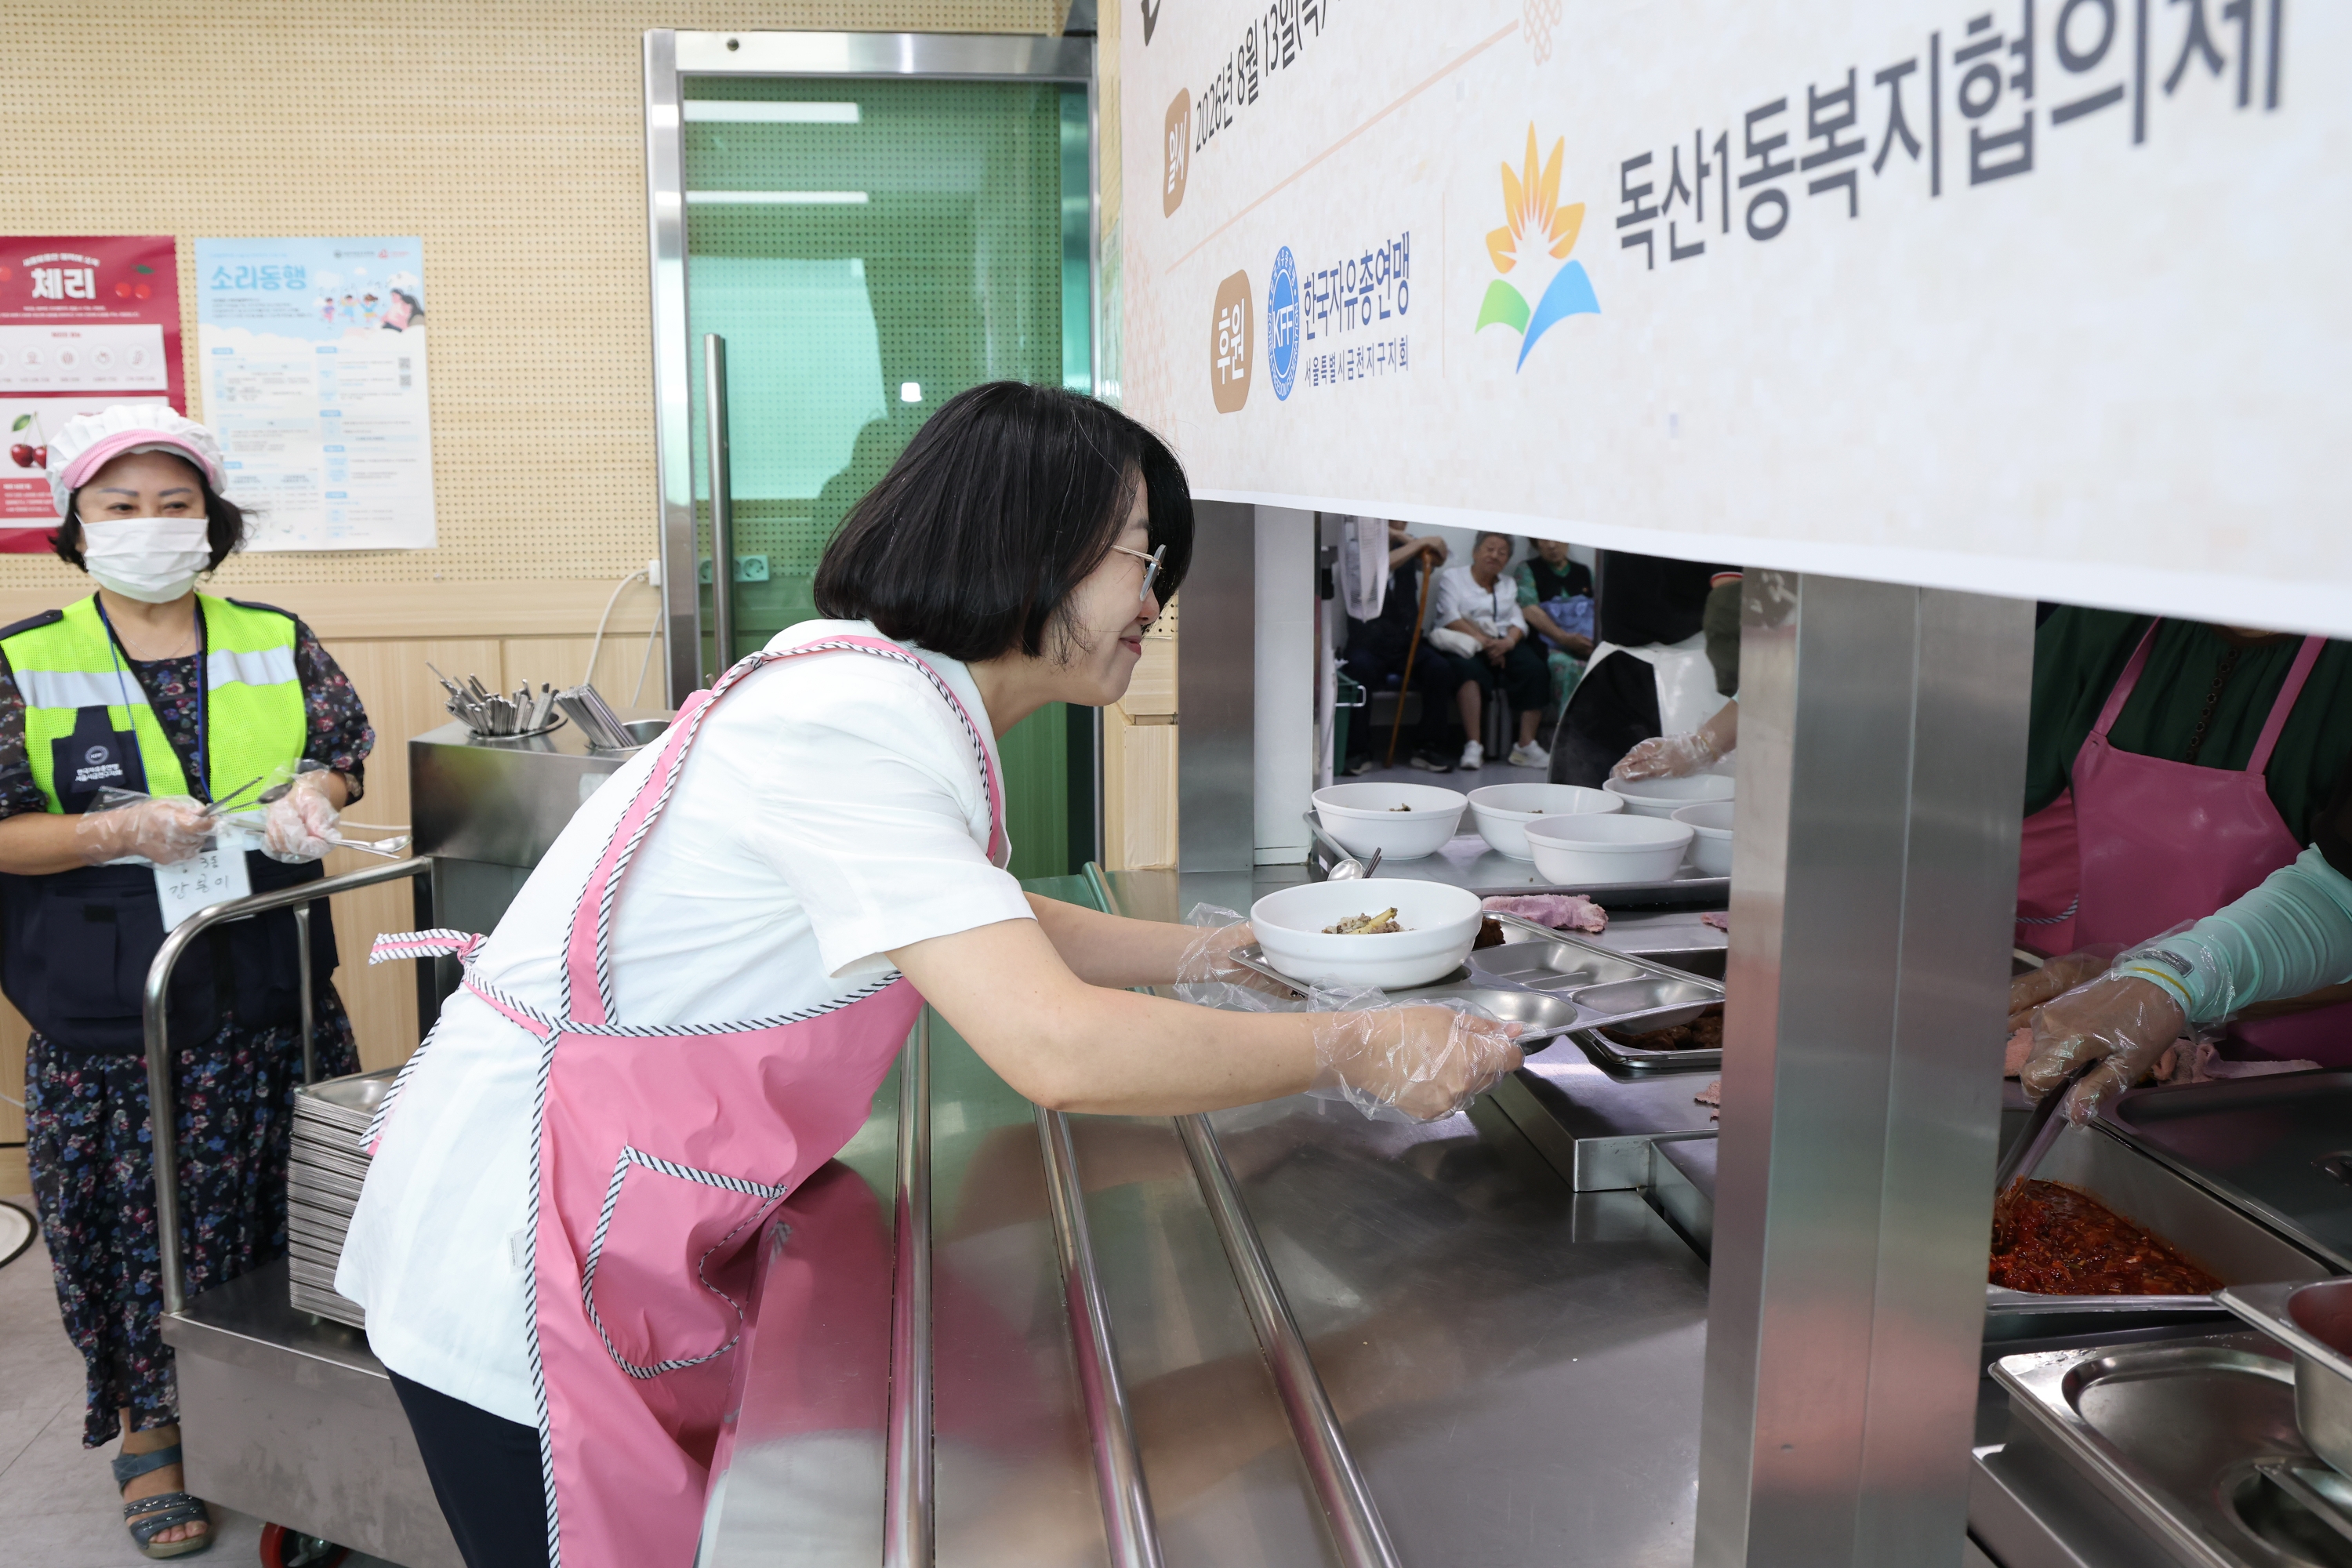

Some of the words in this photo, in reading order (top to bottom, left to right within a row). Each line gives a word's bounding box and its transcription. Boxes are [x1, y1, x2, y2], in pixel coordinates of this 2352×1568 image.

[1196, 51, 1233, 154] 2026년
[1237, 17, 1259, 107] 8월
[1167, 111, 1188, 194] 일시
[31, 267, 96, 299] 체리
[210, 264, 307, 291] 소리동행
[1304, 230, 1410, 340] 한국자유총연맹
[1217, 297, 1246, 386] 후원
[1272, 304, 1293, 350] KFF
[1305, 335, 1408, 387] 서울특별시금천지구지회
